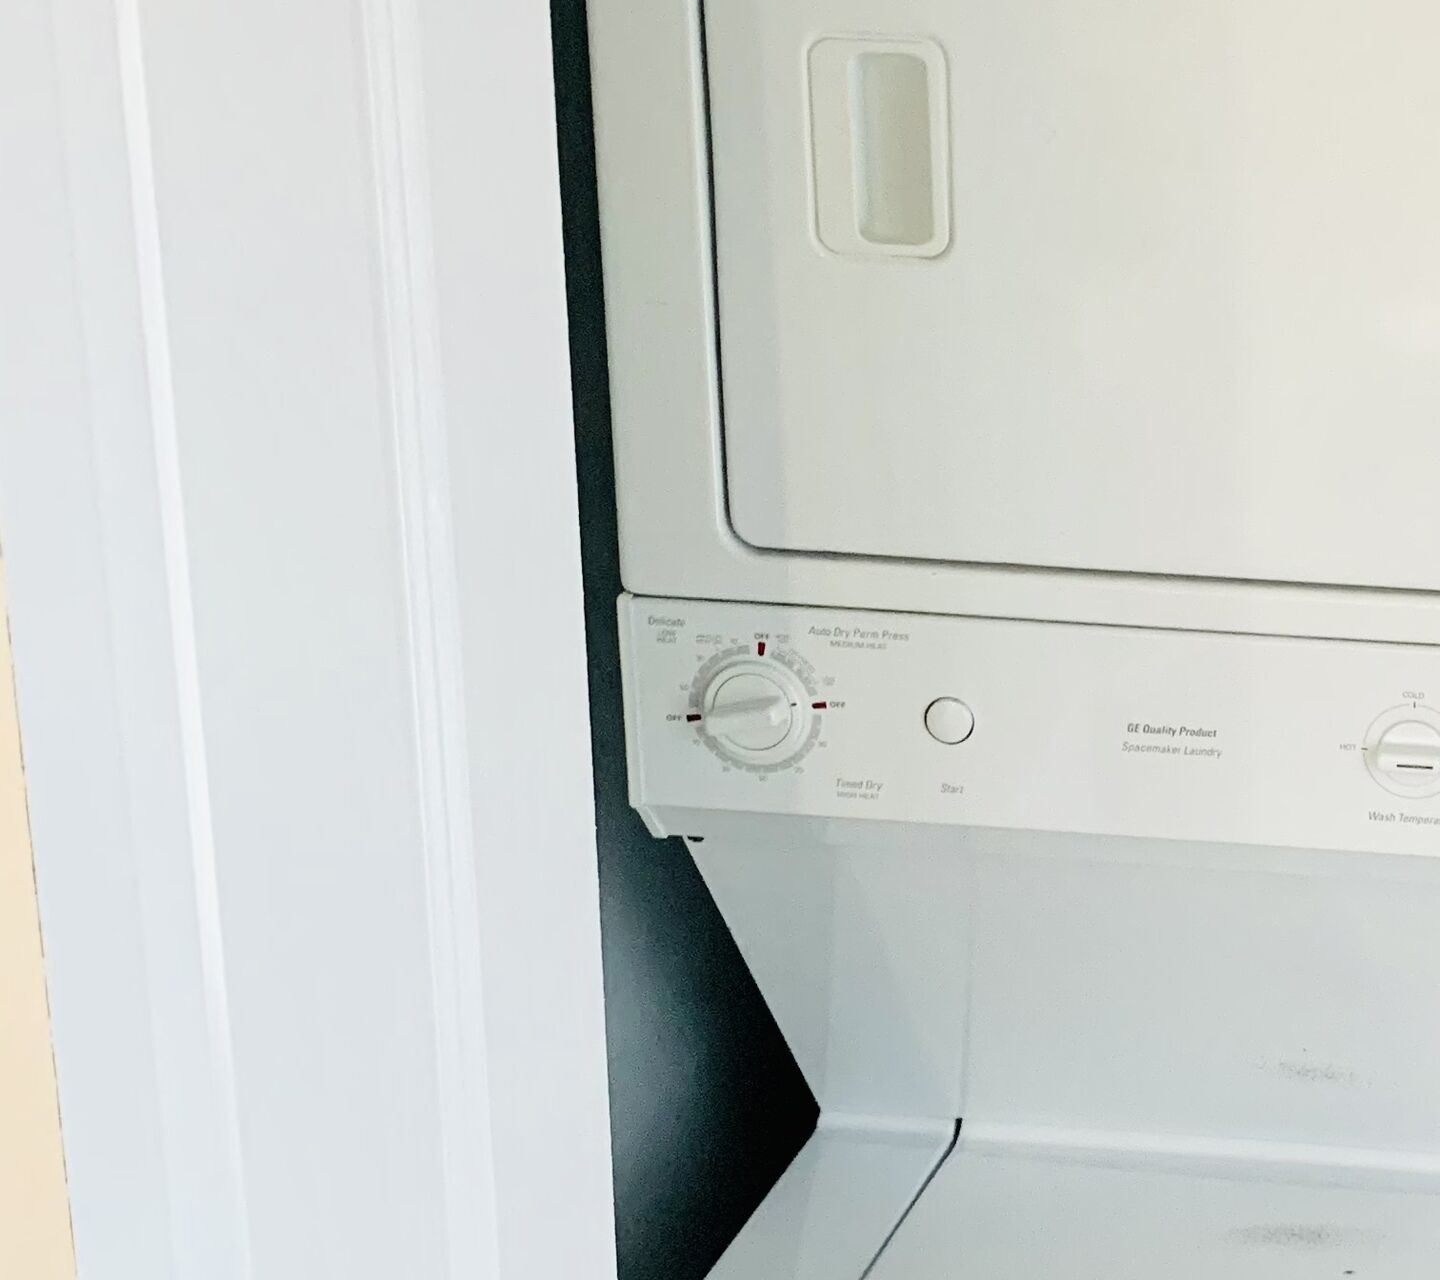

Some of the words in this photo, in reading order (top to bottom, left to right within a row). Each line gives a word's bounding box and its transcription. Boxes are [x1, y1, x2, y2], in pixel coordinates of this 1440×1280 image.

[648, 615, 686, 627] Delicate
[753, 632, 770, 641] OFF
[808, 625, 831, 637] Auto
[833, 626, 850, 639] Dry
[853, 627, 879, 639] Perm
[882, 629, 909, 642] Press
[1401, 691, 1425, 700] COLD
[829, 701, 846, 709] OFF
[665, 713, 682, 722] OFF
[1127, 723, 1141, 733] GE
[1143, 723, 1177, 737] Quality
[1179, 726, 1217, 738] Product
[1121, 741, 1181, 754] Spacemaker
[1183, 746, 1223, 760] Laundry
[1339, 743, 1357, 751] HOT
[865, 779, 884, 792] Dry
[940, 782, 964, 794] Start
[1368, 810, 1396, 822] Wash
